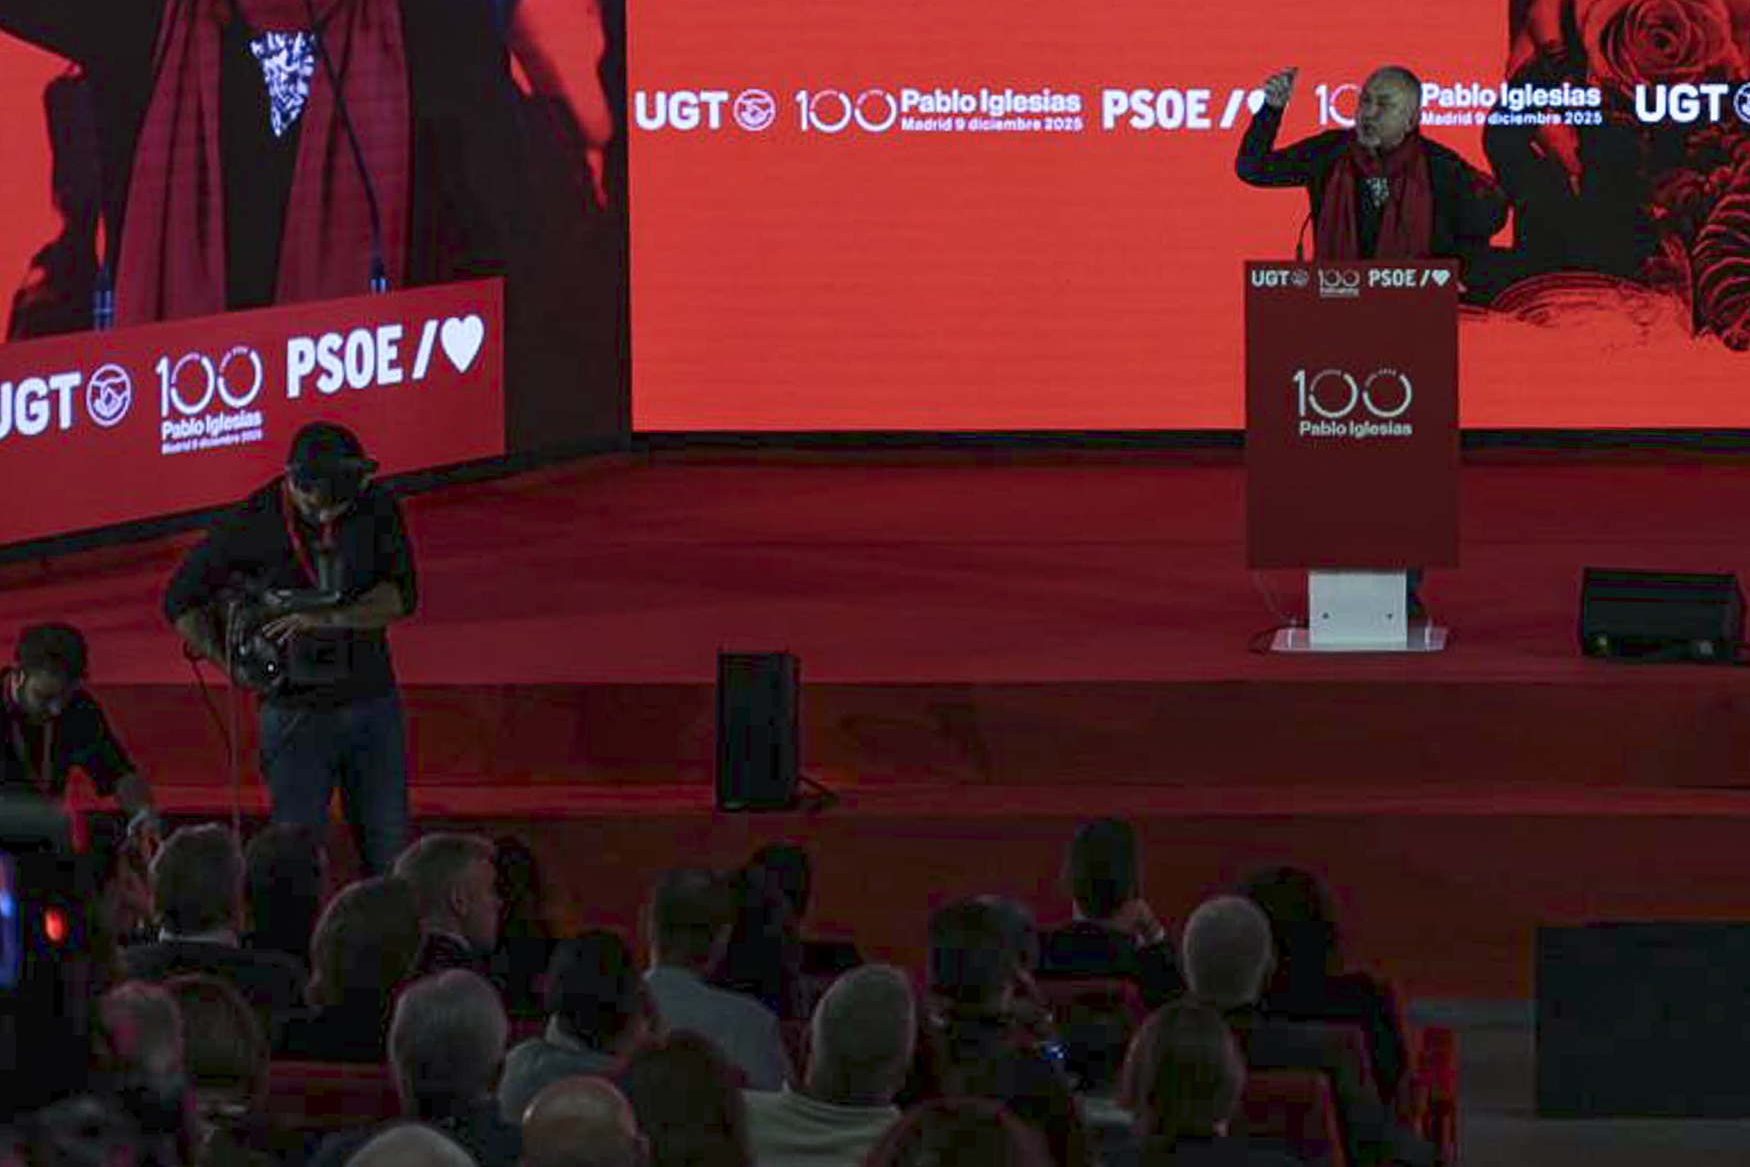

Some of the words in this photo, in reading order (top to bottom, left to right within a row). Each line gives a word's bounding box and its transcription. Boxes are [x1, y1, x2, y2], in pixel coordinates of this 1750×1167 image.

[635, 90, 730, 131] UGT
[795, 89, 898, 132] 100
[901, 87, 977, 112] Pablo
[980, 87, 1081, 116] Iglesias
[1102, 88, 1212, 130] PSOE
[1421, 82, 1497, 108] Pablo
[1501, 82, 1602, 110] Iglesias
[1635, 83, 1729, 123] UGT
[901, 116, 952, 131] Madrid
[1251, 269, 1290, 287] UGT
[1369, 268, 1417, 287] PSOE
[286, 324, 403, 398] PSOE
[155, 346, 263, 418] 100
[1294, 365, 1412, 418] 100
[162, 421, 205, 440] Pablo
[1300, 420, 1347, 436] Pablo
[1350, 420, 1412, 438] Iglesias
